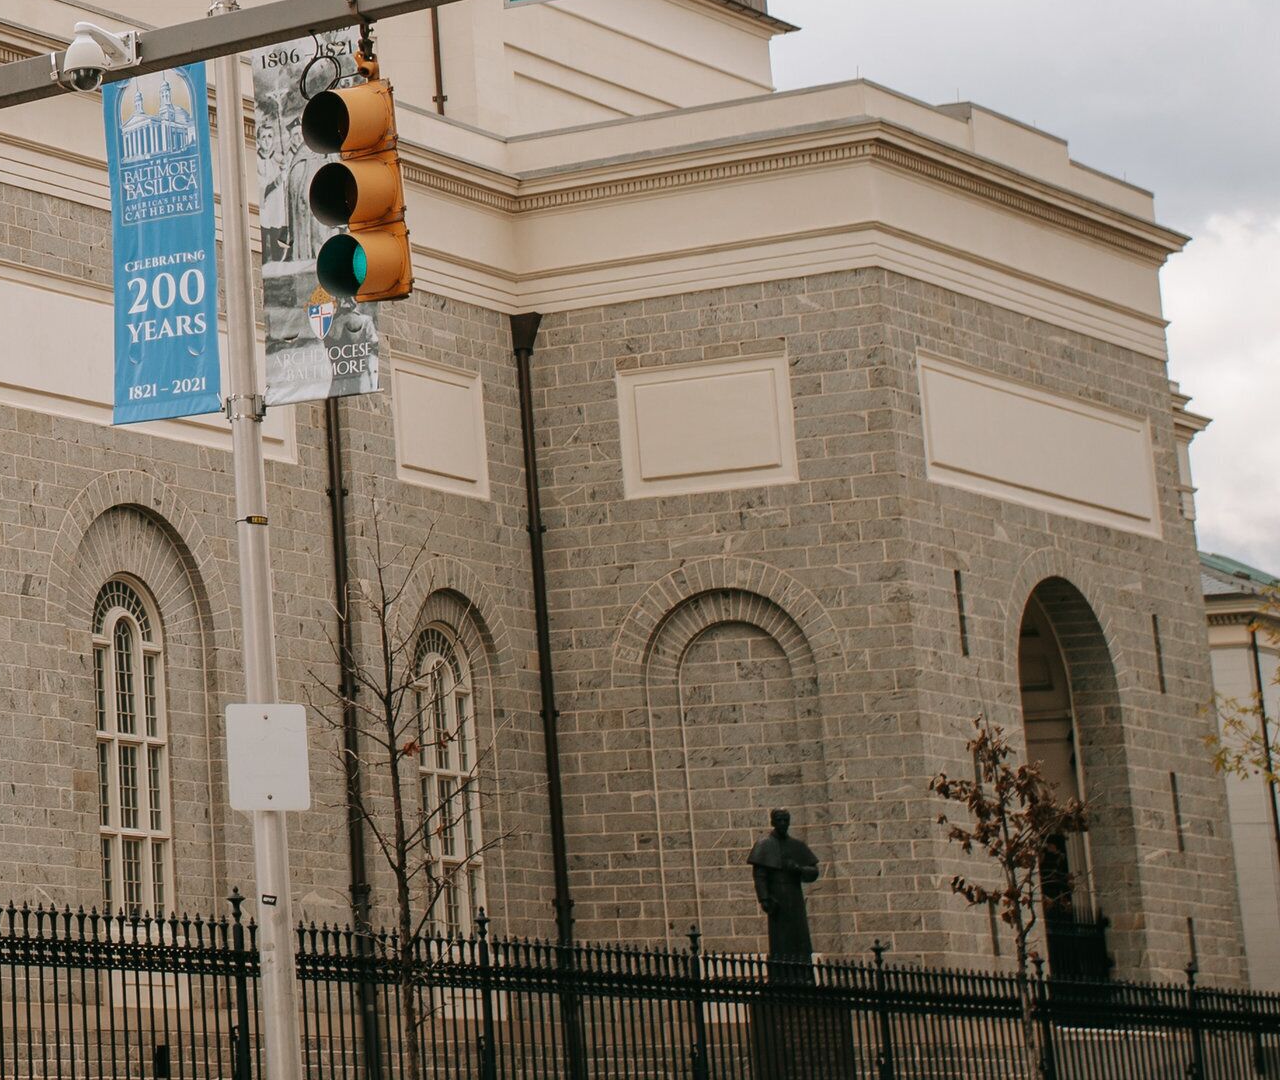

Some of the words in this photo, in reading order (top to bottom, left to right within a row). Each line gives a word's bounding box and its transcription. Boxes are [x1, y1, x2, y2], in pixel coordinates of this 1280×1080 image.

[261, 48, 300, 70] 1806
[319, 39, 353, 57] 1821
[124, 159, 197, 185] BALTIMORE
[150, 158, 168, 166] THE
[125, 173, 198, 201] BASILICA
[125, 198, 168, 212] AMERICA'S
[172, 193, 199, 203] FIRST
[125, 200, 200, 221] CATHEDRAL
[124, 249, 205, 273] CELEBRATING
[127, 269, 205, 315] 200
[126, 312, 207, 344] YEARS
[273, 342, 371, 369] ARCHDIOCESE
[129, 383, 157, 400] 1821
[172, 376, 206, 394] 2021
